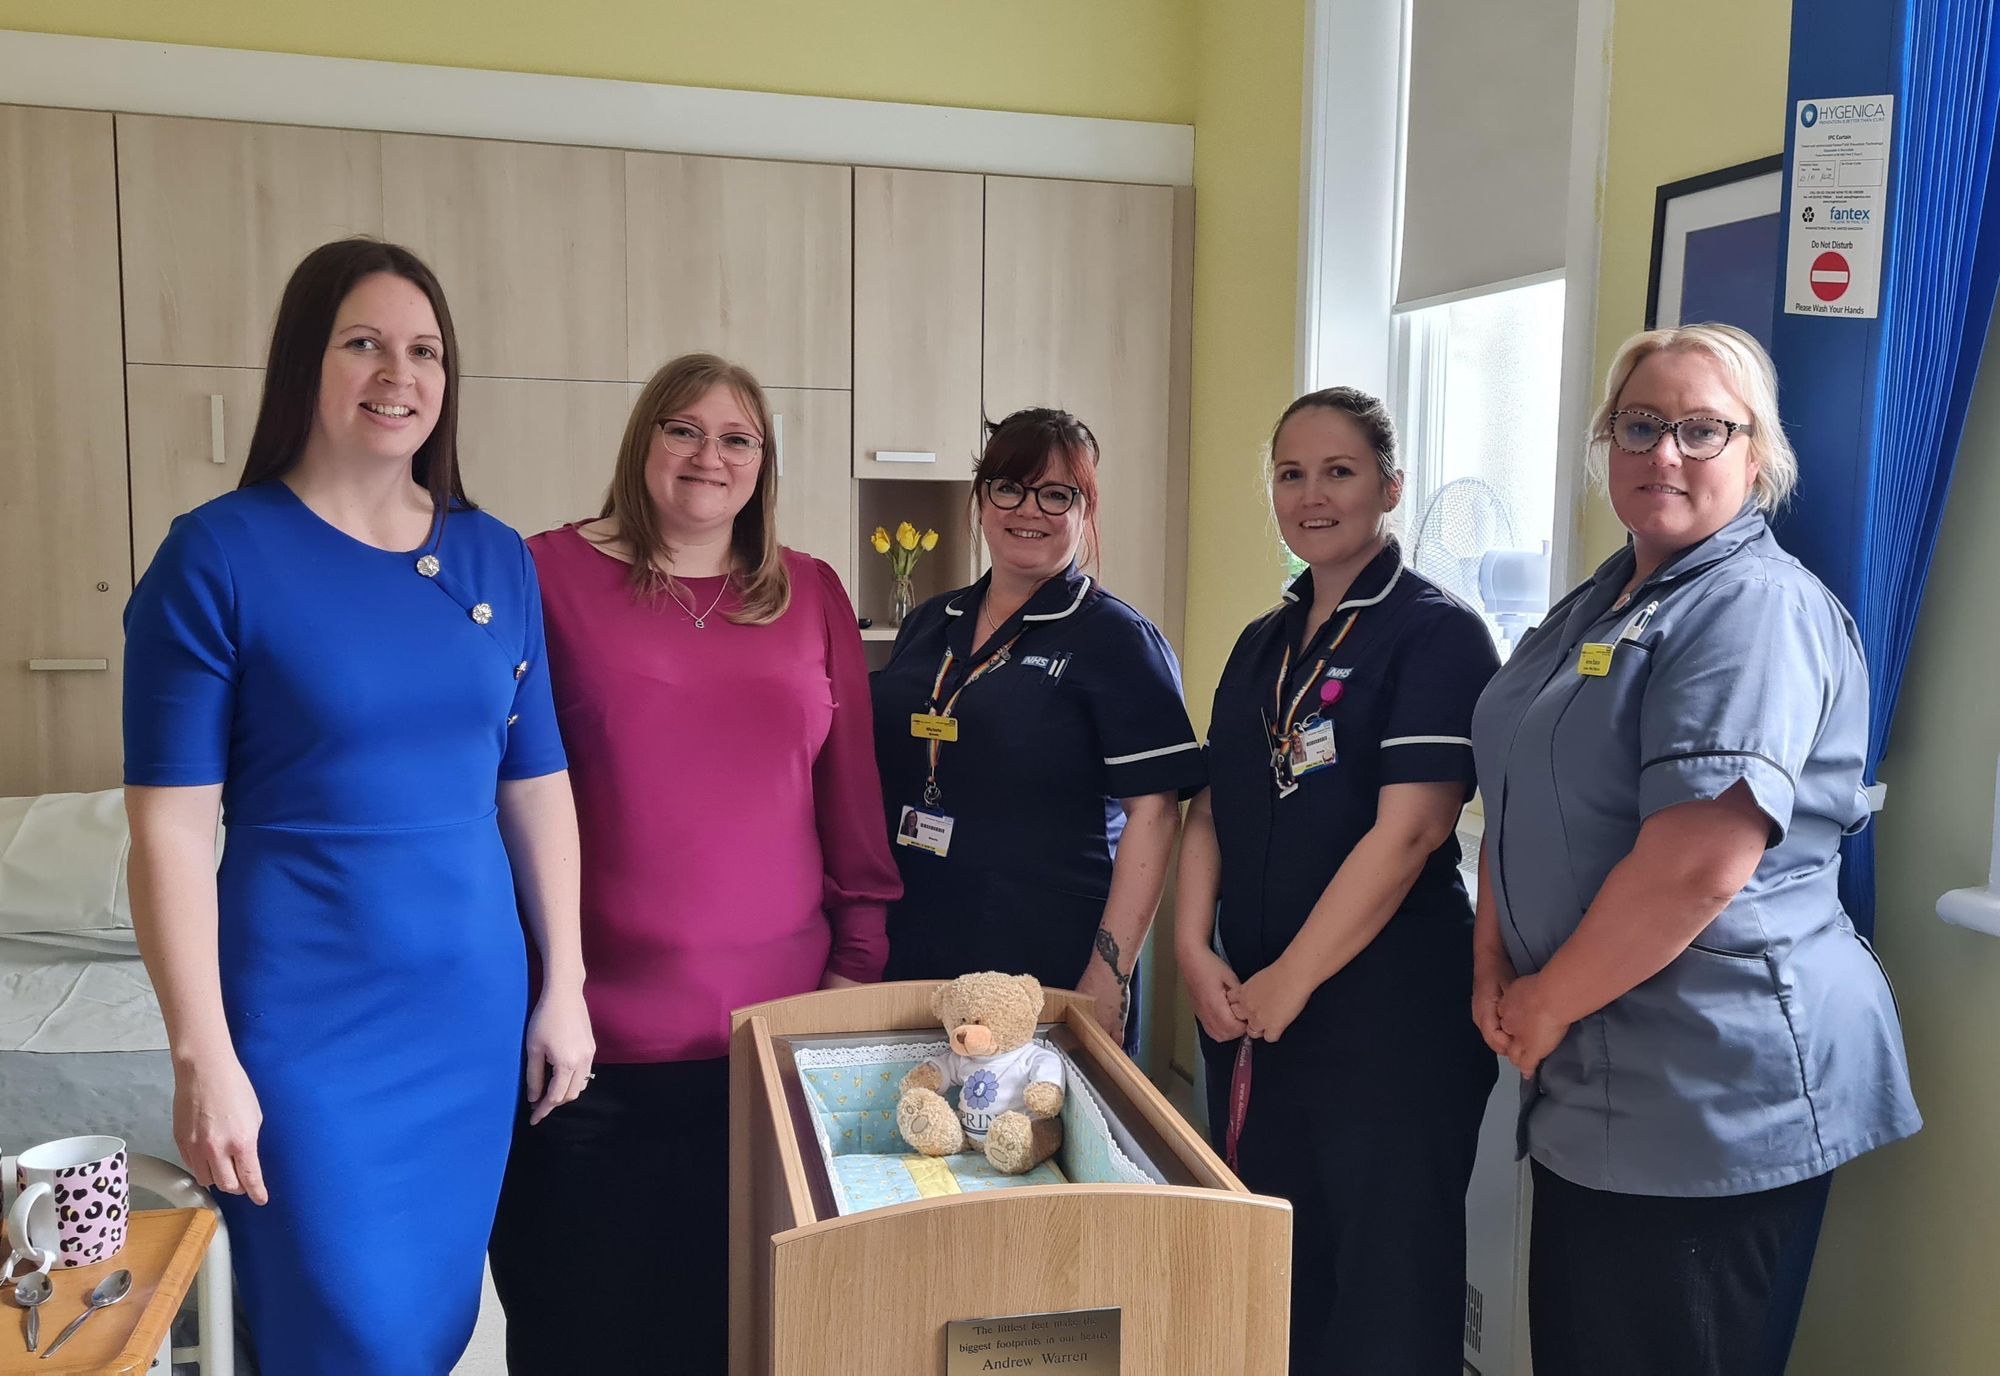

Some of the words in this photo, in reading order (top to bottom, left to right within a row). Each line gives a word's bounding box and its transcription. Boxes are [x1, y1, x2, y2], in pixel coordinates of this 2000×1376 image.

[1820, 103, 1885, 119] HYGENICA
[1830, 206, 1871, 220] fantex
[1811, 240, 1819, 249] Do
[1820, 240, 1831, 249] Not
[1832, 240, 1854, 250] Disturb
[1795, 303, 1811, 312] Please
[1812, 304, 1828, 313] Wash
[1829, 305, 1844, 314] Your
[1844, 306, 1865, 315] Hands
[1023, 656, 1049, 668] NHS
[1326, 666, 1352, 679] NHS
[998, 1323, 1026, 1333] littlest
[1031, 1320, 1048, 1330] feet
[1054, 1318, 1077, 1328] make
[1083, 1317, 1096, 1327] the
[959, 1342, 991, 1354] biggest
[996, 1338, 1041, 1350] footprints
[1046, 1336, 1055, 1345] in
[1060, 1335, 1074, 1343] our
[982, 1357, 1034, 1371] Andrew
[1042, 1352, 1088, 1365] Warren
